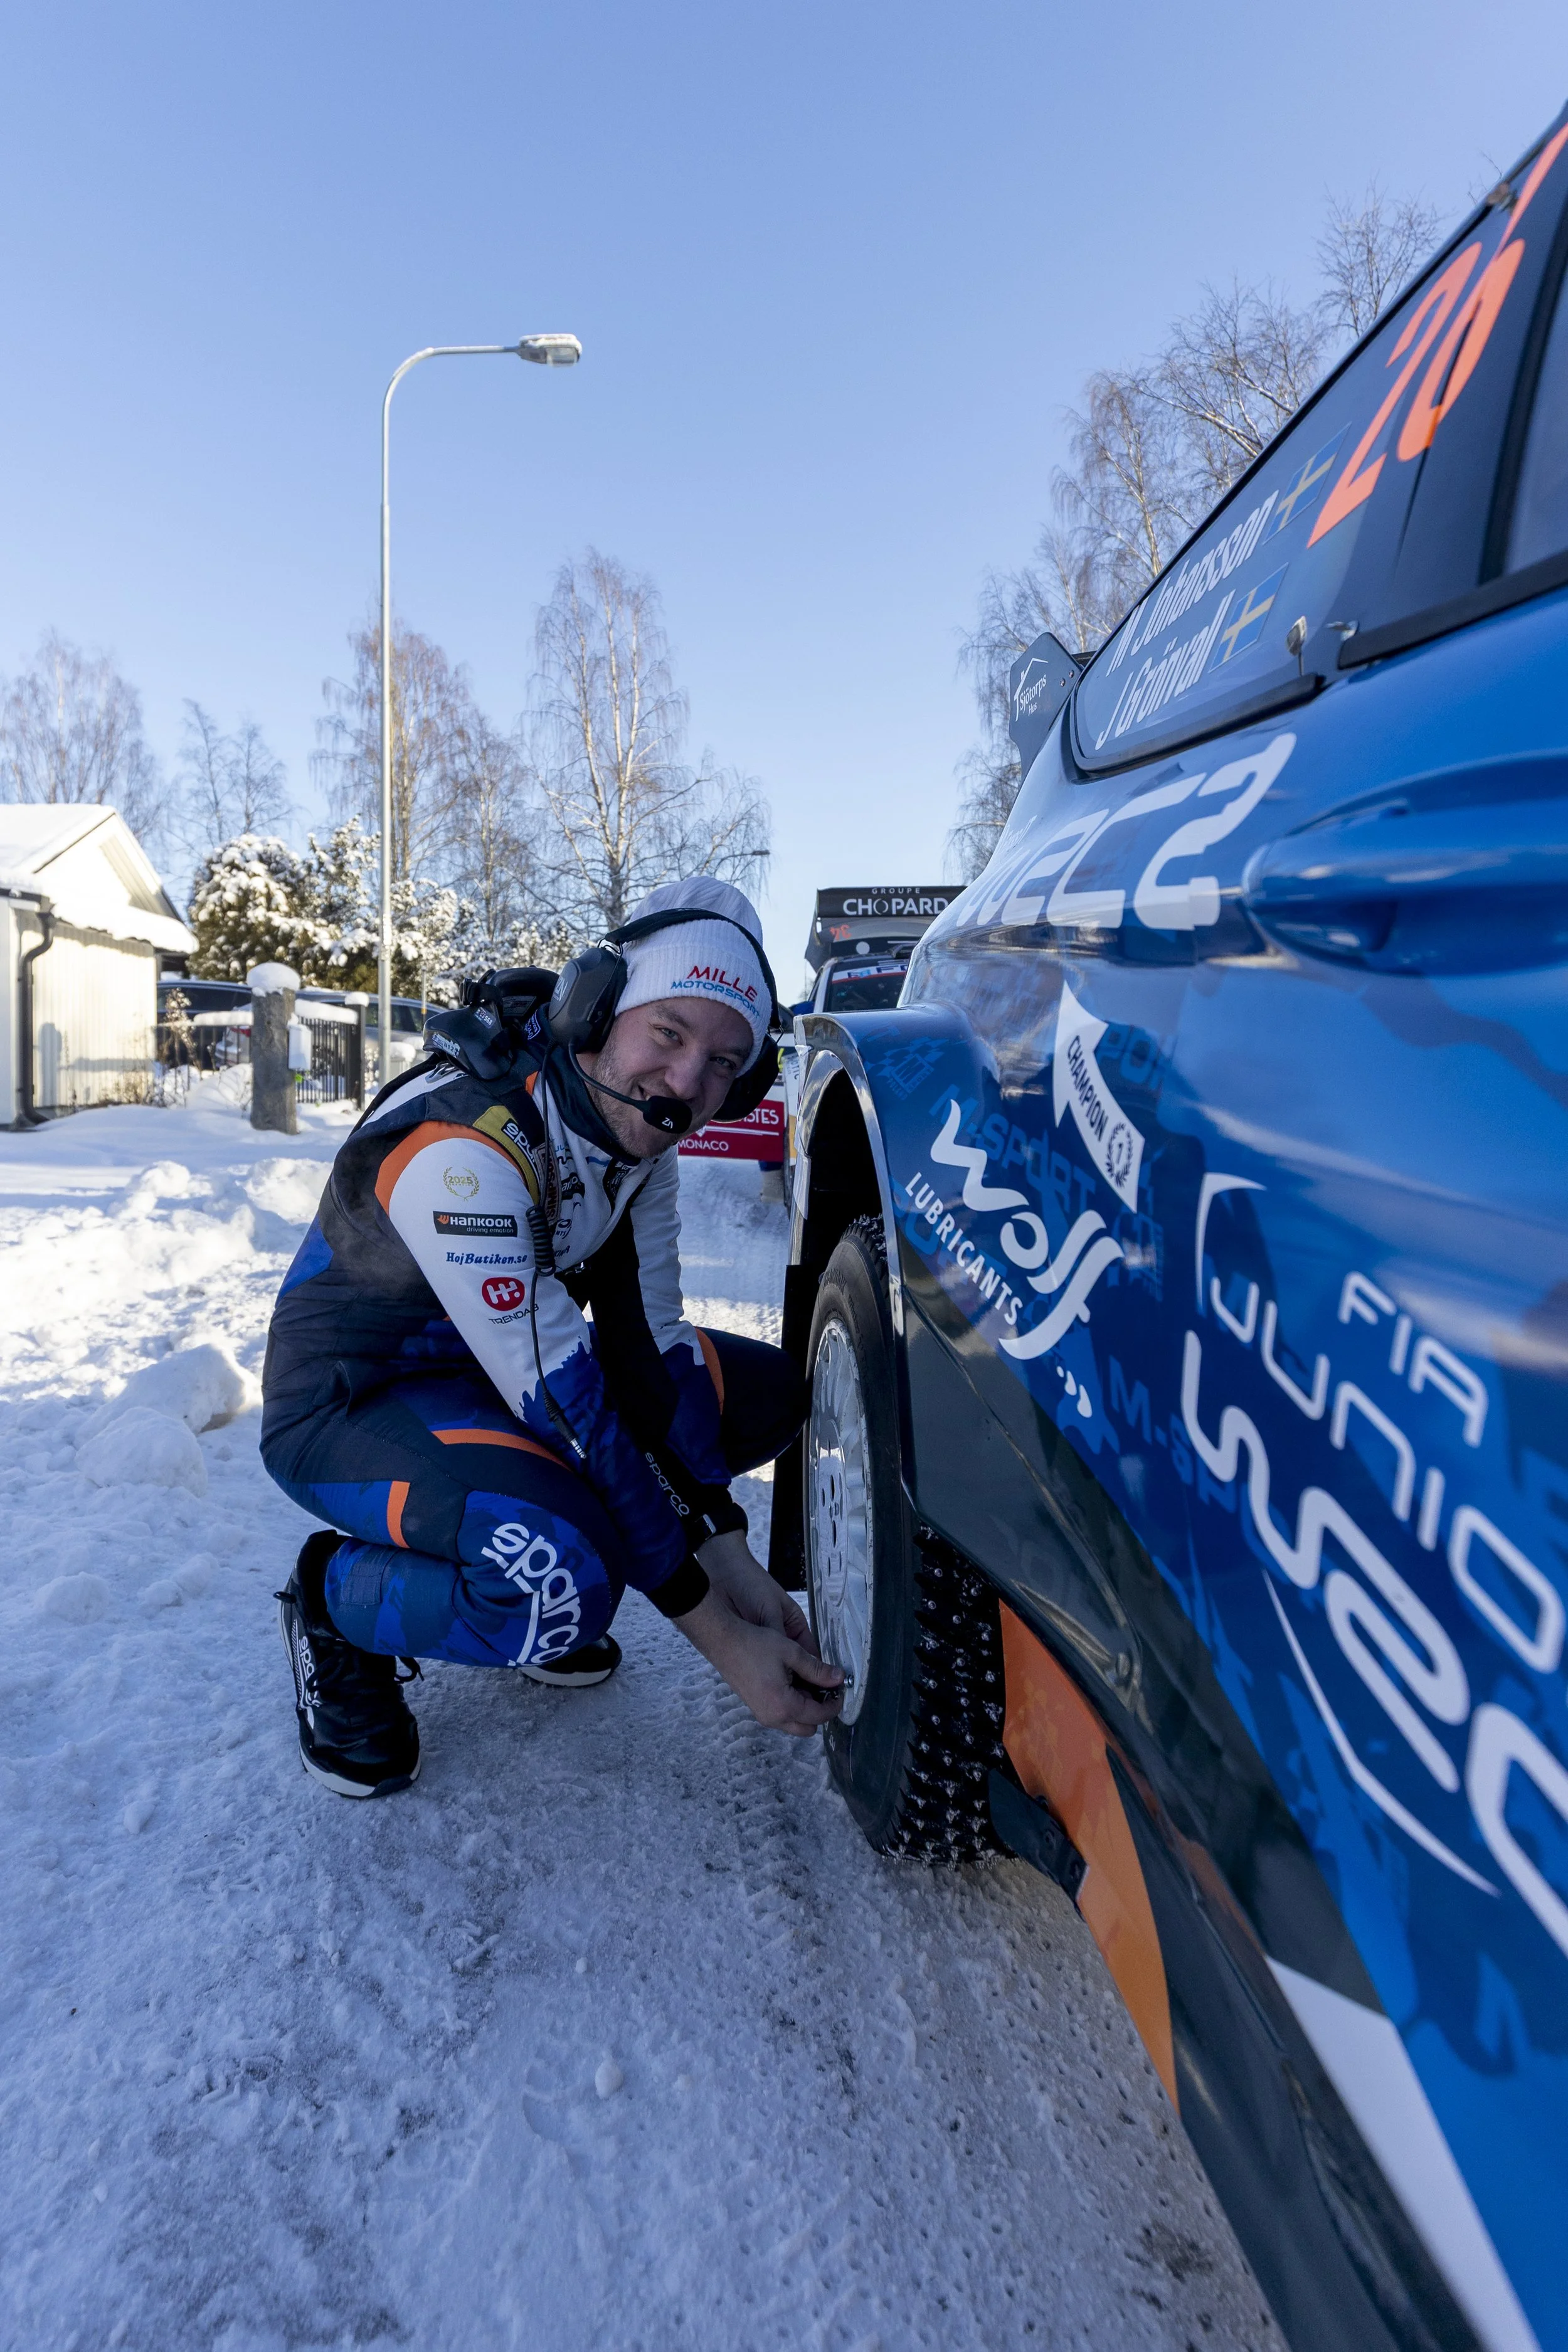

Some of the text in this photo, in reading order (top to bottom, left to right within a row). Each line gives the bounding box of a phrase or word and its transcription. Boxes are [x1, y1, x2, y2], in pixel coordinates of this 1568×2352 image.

[1130, 489, 1279, 657] Johansson
[1115, 589, 1236, 738] Grönvall
[1019, 674, 1047, 714] Sjötorps
[1028, 702, 1037, 716] Hus
[842, 897, 949, 916] CHOPARD
[670, 980, 761, 1017] MOTORSPORT
[686, 965, 758, 1003] MILLE
[1067, 1034, 1110, 1143] CHAMPION
[744, 1108, 780, 1125] STES
[448, 1175, 474, 1185] 2025
[445, 1251, 528, 1266] HojButiken.se
[904, 1171, 1024, 1327] LUBRICANTS
[1337, 1271, 1488, 1448] FIA
[644, 1451, 690, 1517] sparco
[1210, 1276, 1568, 1687] JUNIO
[481, 1522, 582, 1665] sparco
